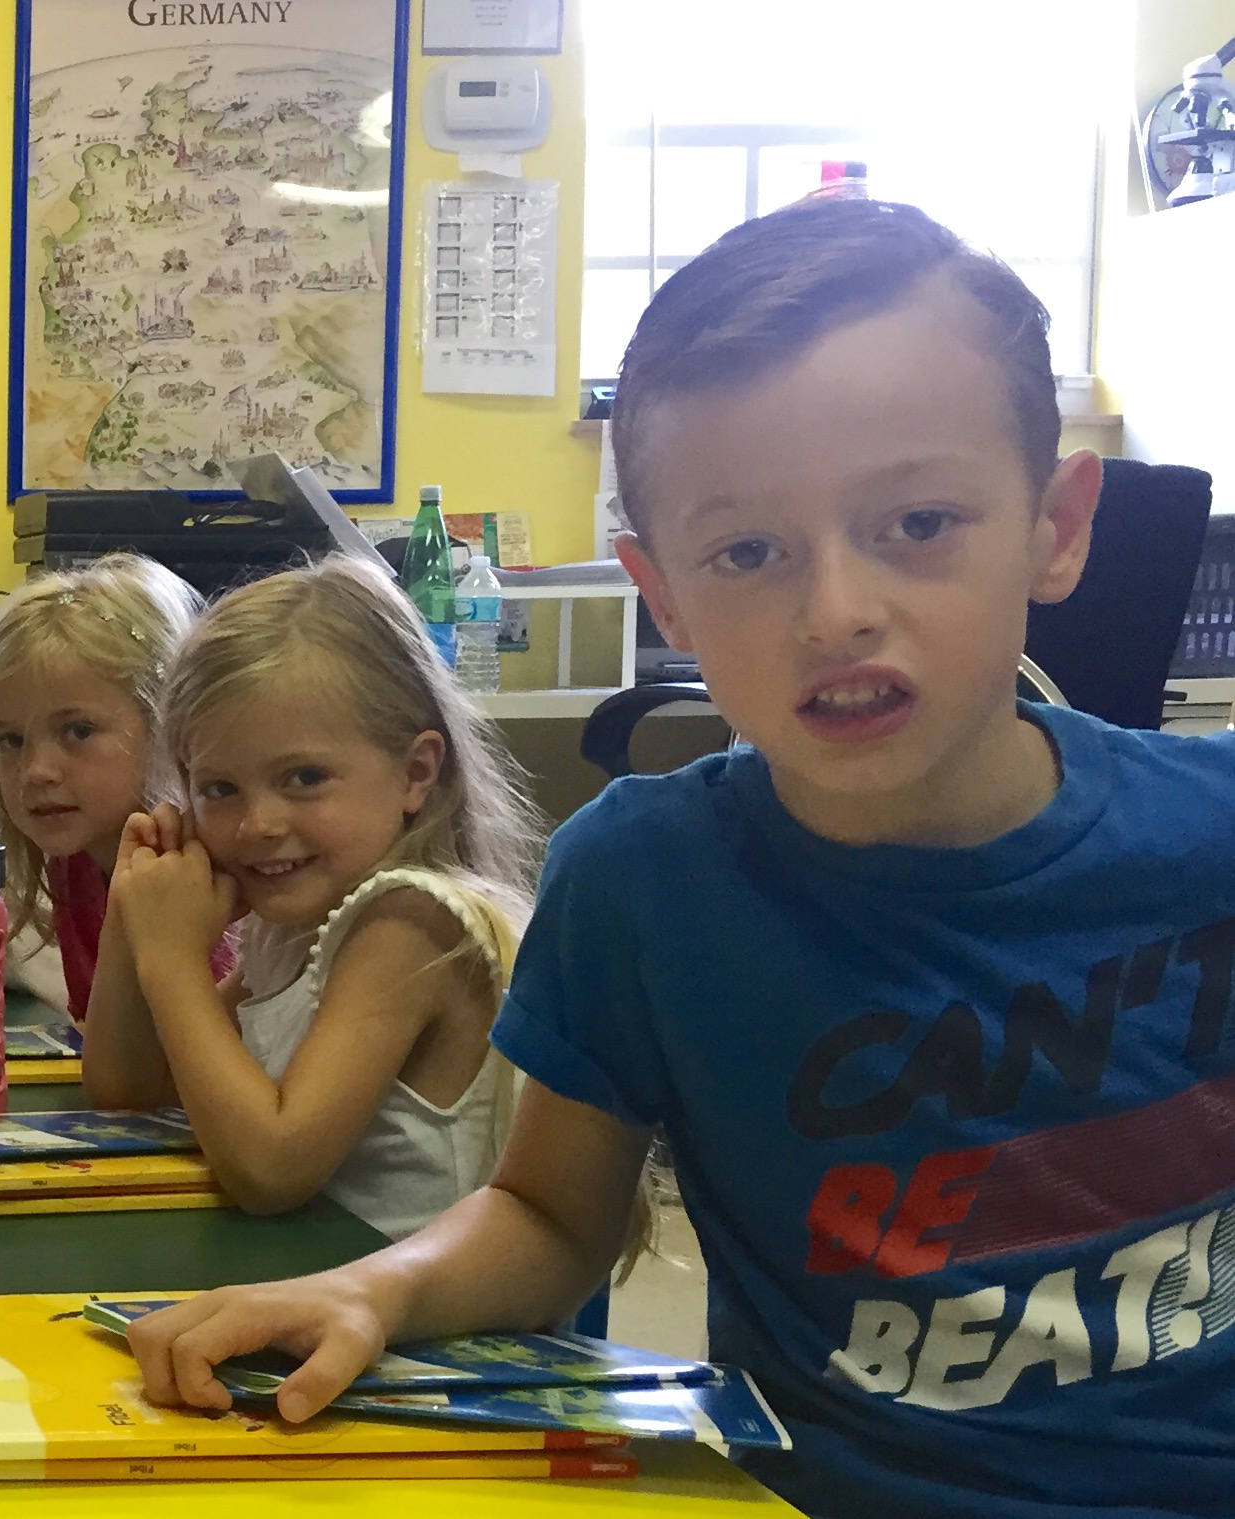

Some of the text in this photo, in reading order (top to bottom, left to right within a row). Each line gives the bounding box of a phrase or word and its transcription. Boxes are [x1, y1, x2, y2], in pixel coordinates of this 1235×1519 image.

[785, 916, 1235, 1141] CAN'T
[806, 1144, 1001, 1280] BE
[823, 1209, 1221, 1411] BEAT!
[97, 1403, 137, 1427] Fibel
[129, 1465, 154, 1474] Fibel
